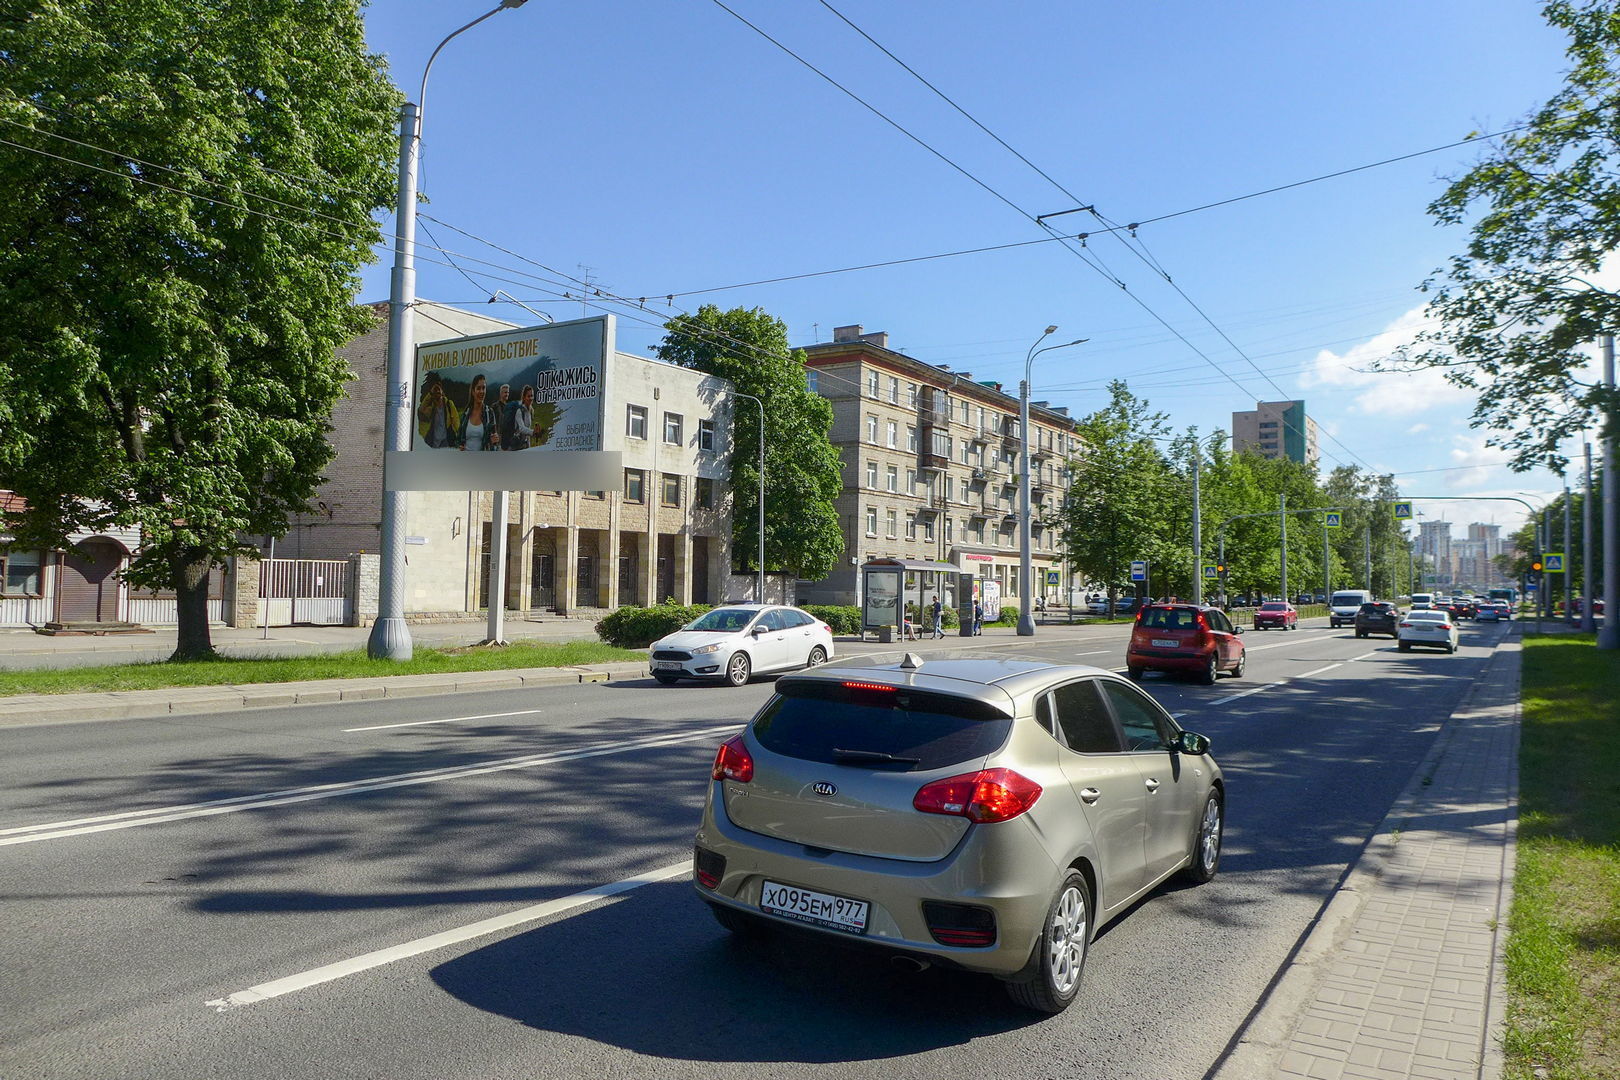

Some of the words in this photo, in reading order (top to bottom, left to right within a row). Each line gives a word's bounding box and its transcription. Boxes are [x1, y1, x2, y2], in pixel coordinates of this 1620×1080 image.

[422, 351, 450, 371] ЖИВИ
[452, 350, 458, 367] В
[461, 338, 539, 367] УДОВОЛЬСТВИЕ
[538, 365, 597, 390] ОТКАЖИСЬ
[537, 390, 547, 403] ОТ
[547, 385, 597, 402] НАРКОТИКОВ
[566, 421, 595, 435] ВЫБИРАЙ
[556, 434, 595, 448] БЕЗОПАСНОЕ
[815, 783, 833, 795] KIA
[836, 898, 863, 918] 977
[840, 915, 854, 923] RUS
